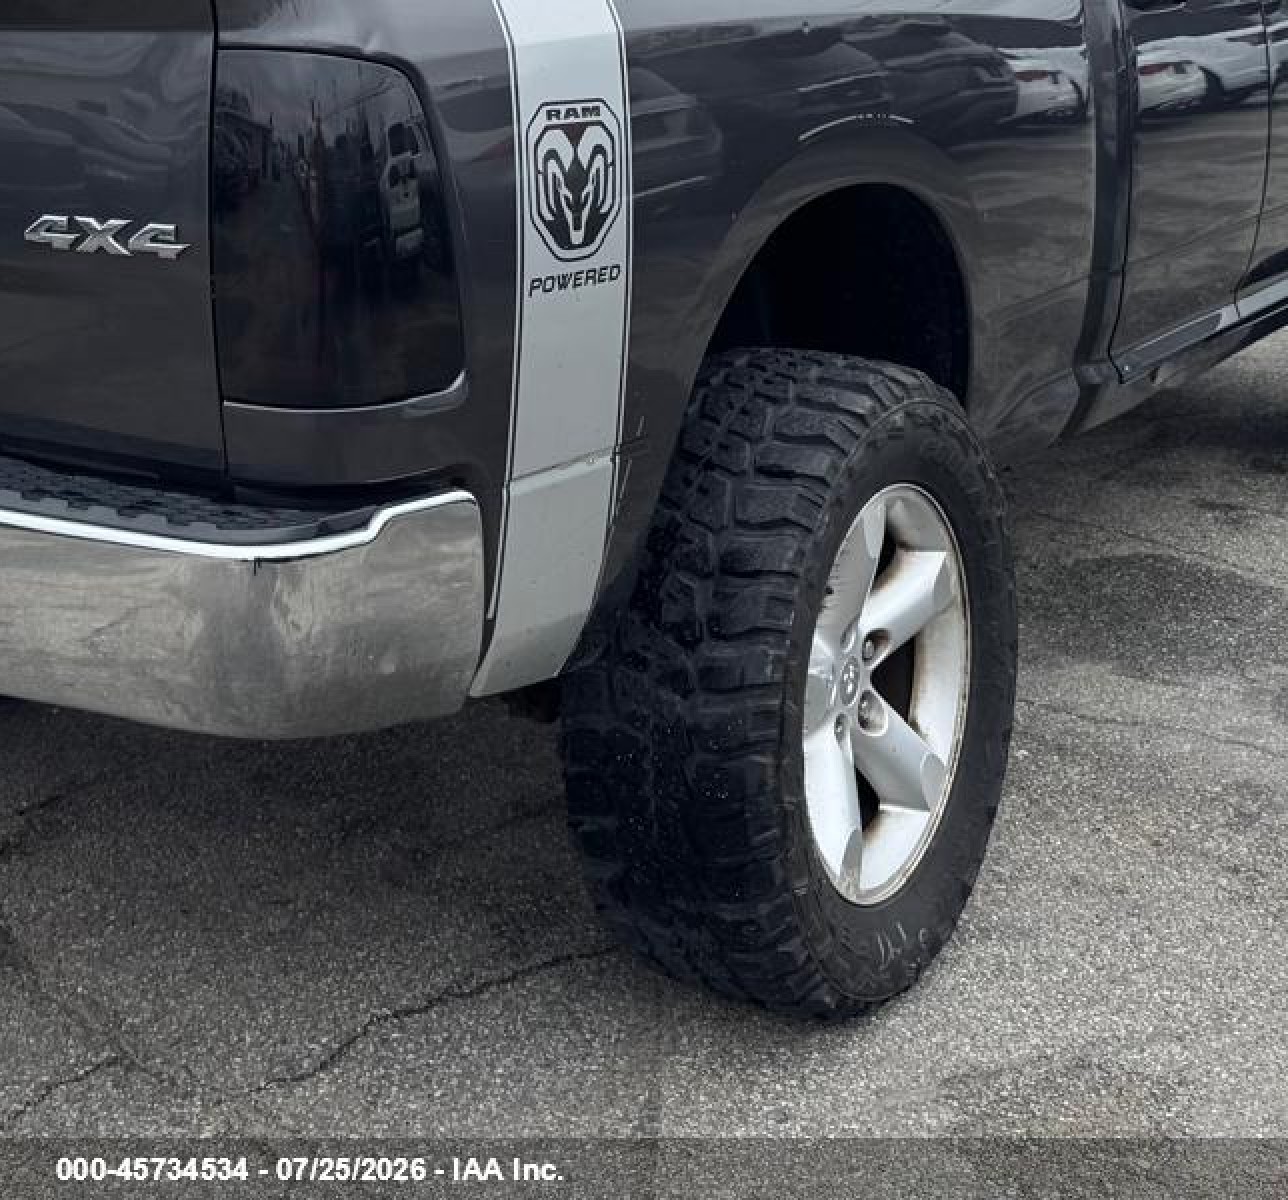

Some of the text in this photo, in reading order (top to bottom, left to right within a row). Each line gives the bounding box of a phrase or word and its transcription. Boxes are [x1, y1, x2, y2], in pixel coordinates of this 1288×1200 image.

[545, 106, 601, 121] RAM
[23, 214, 192, 260] 4X4
[528, 263, 621, 299] POWERED
